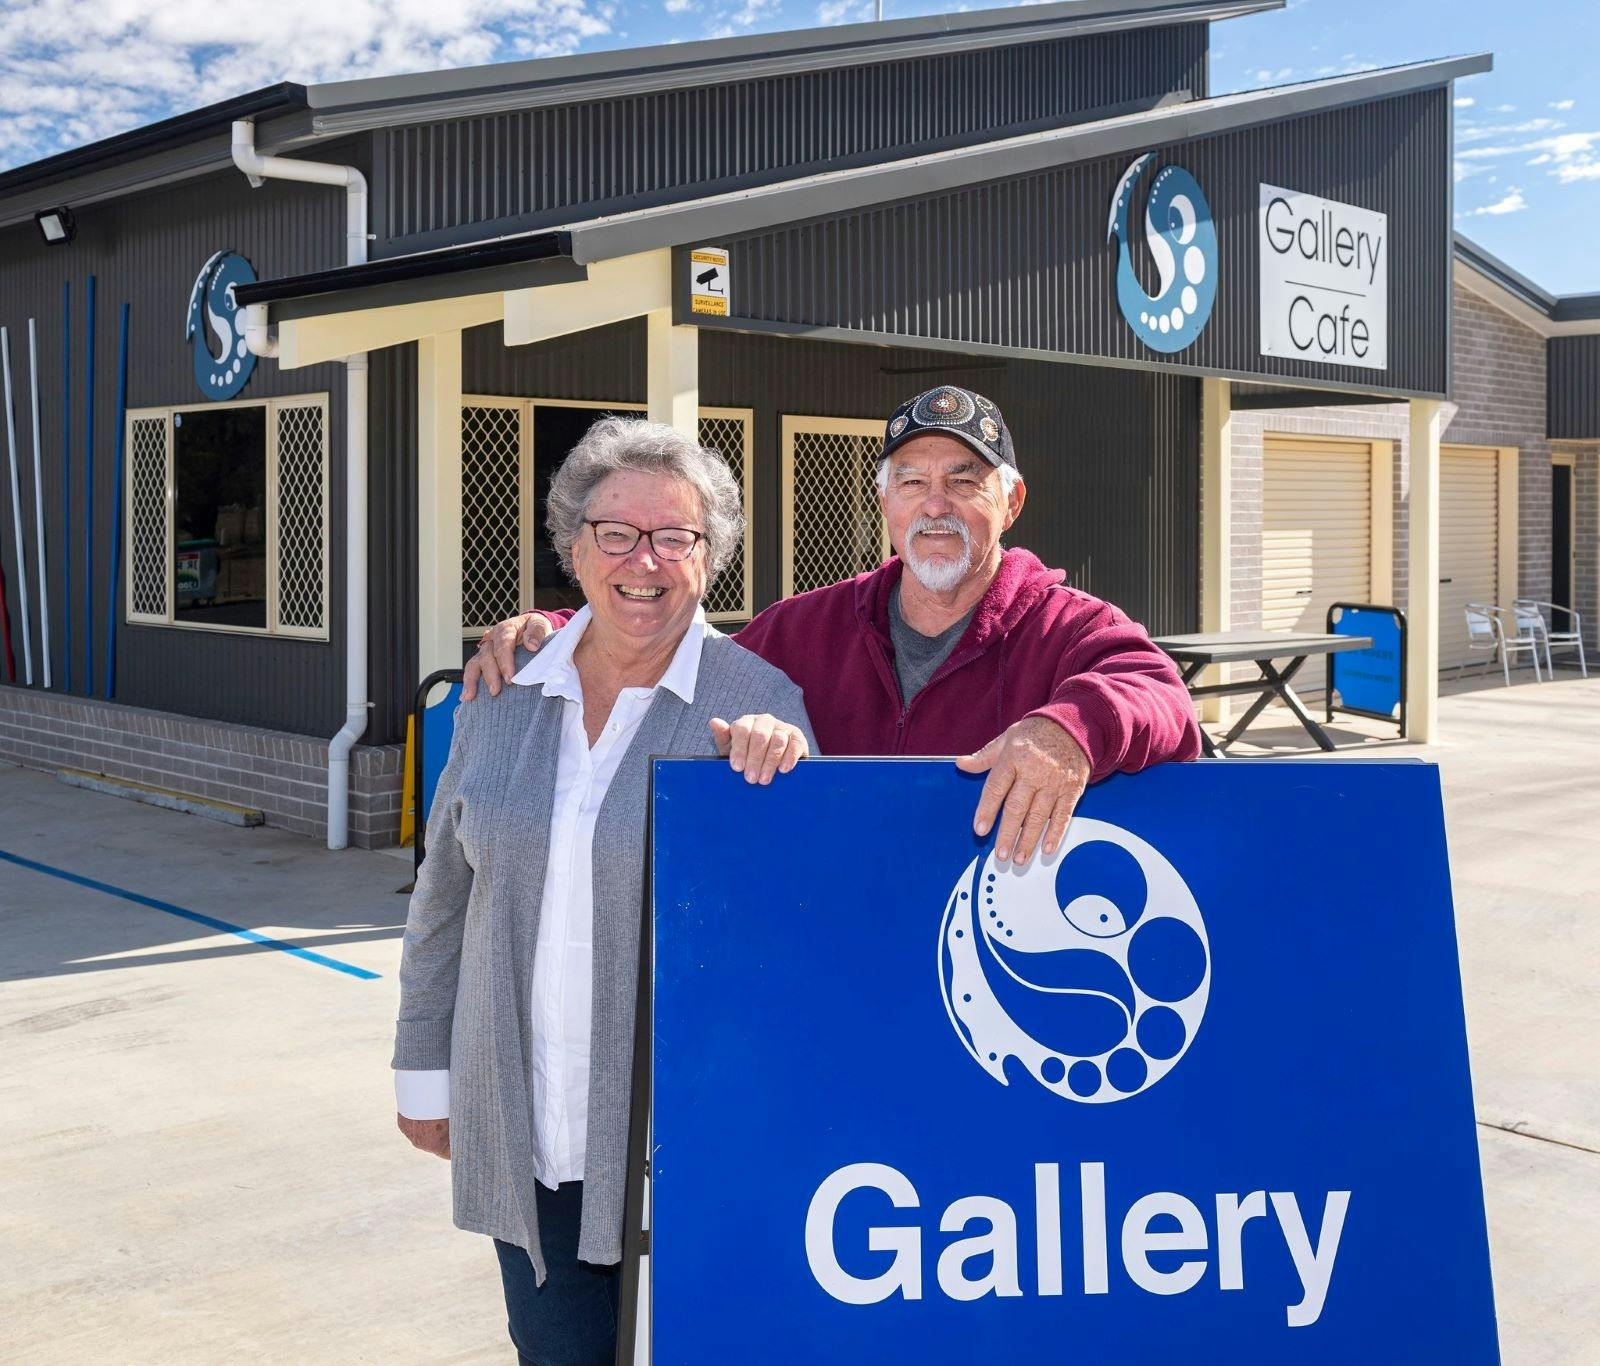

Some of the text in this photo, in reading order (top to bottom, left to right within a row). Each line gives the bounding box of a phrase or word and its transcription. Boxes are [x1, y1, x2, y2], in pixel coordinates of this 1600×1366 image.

[1265, 197, 1381, 285] Gallery
[1289, 295, 1369, 358] Cafe
[805, 1162, 1352, 1327] Gallery
